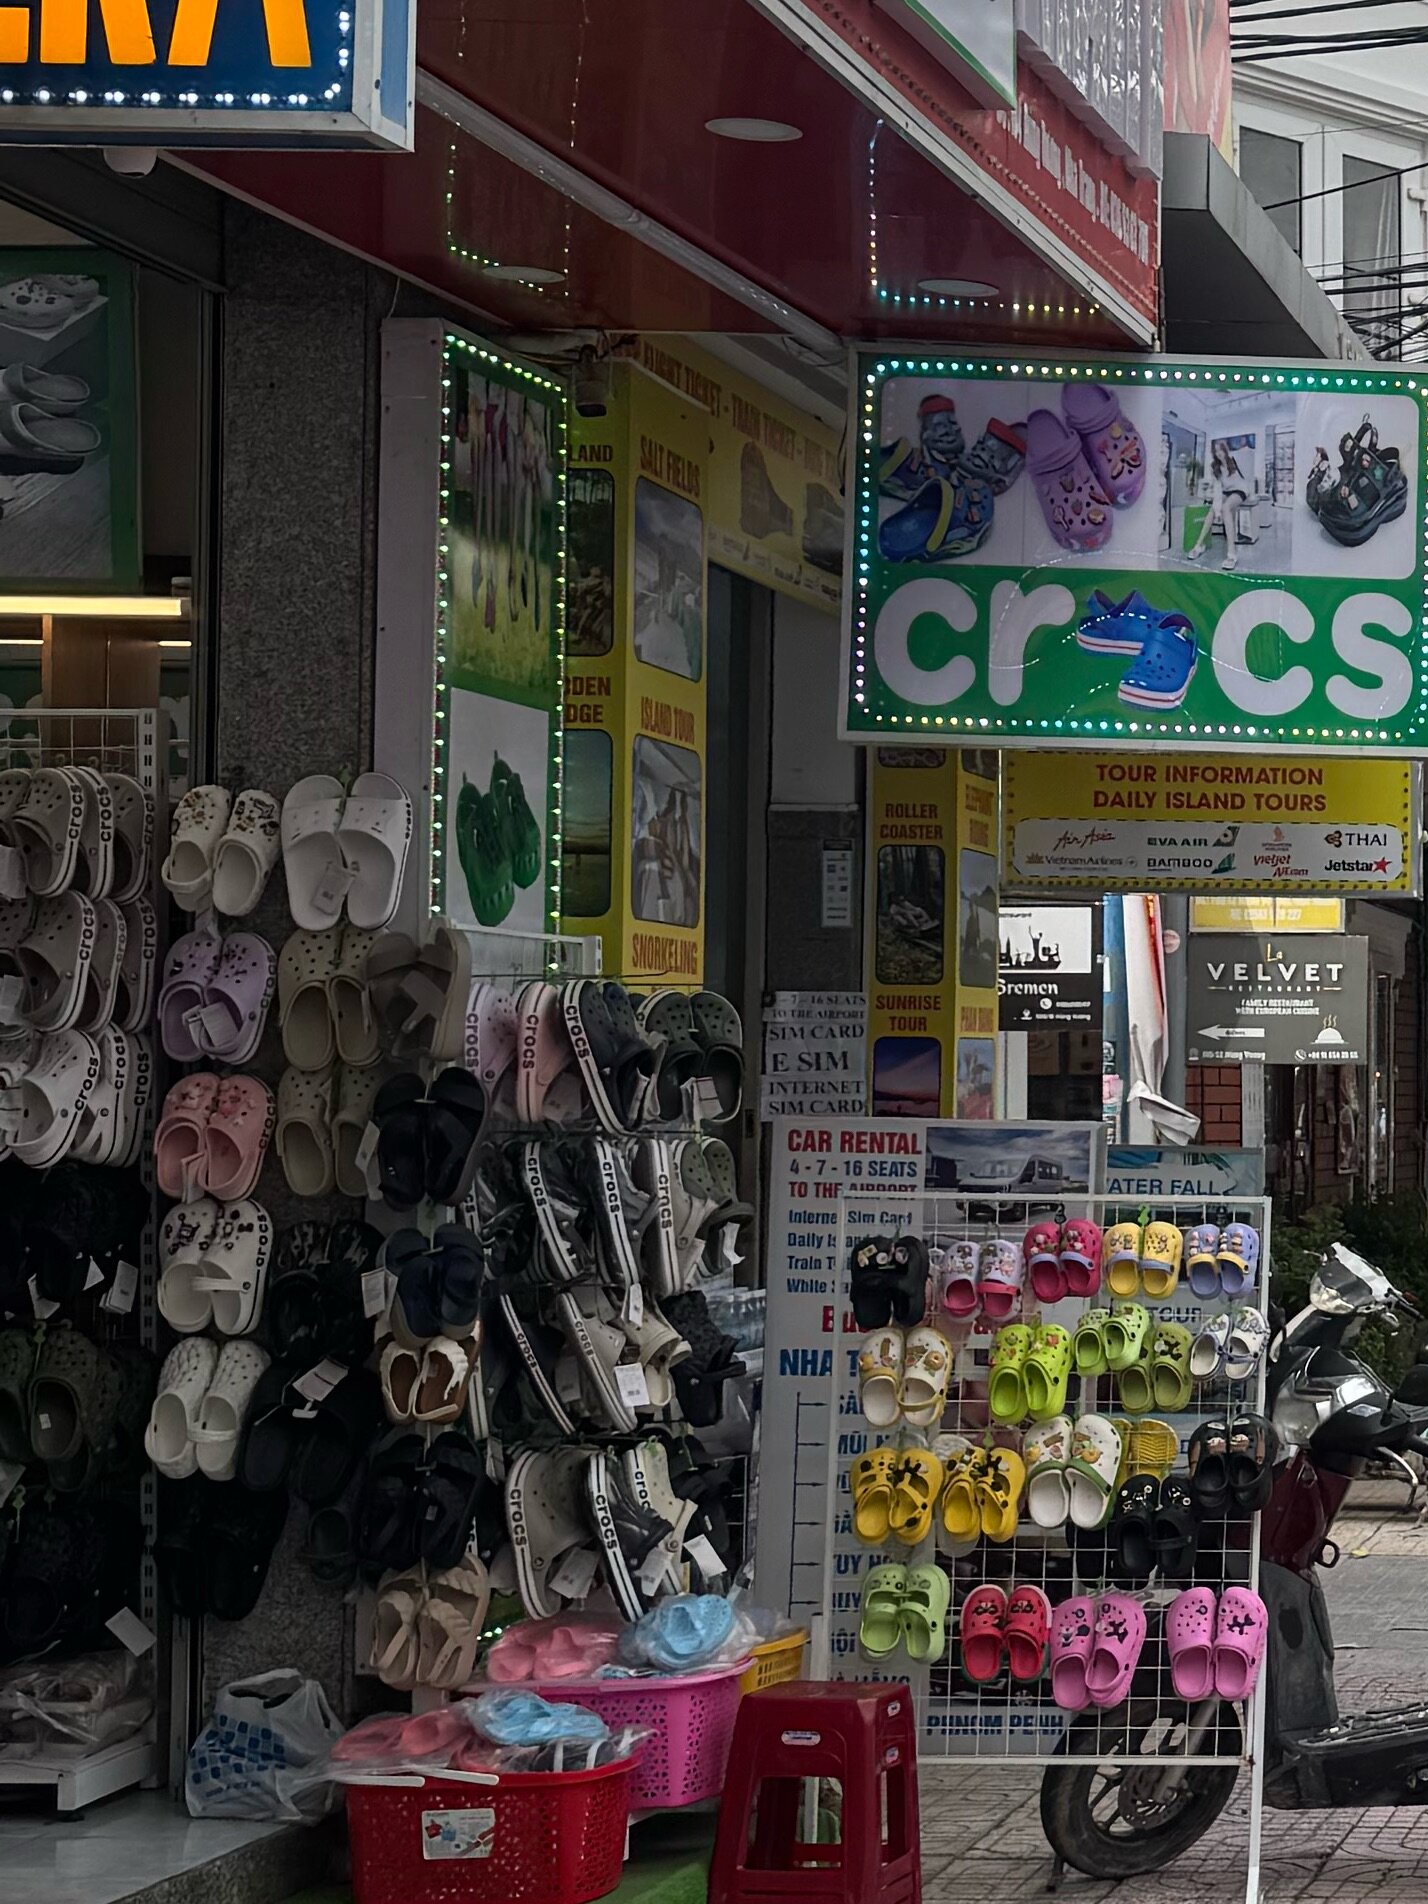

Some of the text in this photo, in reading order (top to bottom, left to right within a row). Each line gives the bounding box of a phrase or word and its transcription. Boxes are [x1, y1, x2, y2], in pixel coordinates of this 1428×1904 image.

[568, 445, 613, 462] LAND
[640, 435, 701, 499] SALT FIELDS
[874, 577, 1414, 720] crcs
[641, 696, 696, 745] ISLAND TOUR
[1096, 764, 1324, 786] TOUR INFORMATION
[69, 784, 83, 840] crocs
[885, 803, 938, 819] ROLLER
[1093, 791, 1327, 812] DAILY ISLAND TOURS
[100, 787, 113, 842] crocs
[880, 824, 943, 840] COASTER
[1180, 837, 1209, 847] AIR
[1345, 833, 1387, 847] THAI
[1325, 860, 1374, 872] Jetstar
[80, 907, 93, 961] crocs
[632, 934, 699, 975] SNORKELING
[1267, 943, 1283, 962] La
[1207, 962, 1344, 982] VELVET
[875, 994, 942, 1012] SUNRISE
[565, 1005, 591, 1058] crocs
[770, 1024, 864, 1041] SIM CARD
[889, 1016, 927, 1032] TOUR
[466, 1013, 479, 1068] crocs
[522, 1014, 539, 1069] crocs
[115, 1033, 126, 1089] crocs
[772, 1050, 849, 1072] E SIM
[75, 1056, 100, 1110] crocs
[134, 1052, 149, 1106] crocs
[769, 1080, 863, 1095] INTERNET
[769, 1099, 863, 1115] SIM CARD
[787, 1129, 922, 1155] CAR RENTAL
[790, 1161, 799, 1175] 4
[816, 1160, 826, 1176] 7
[844, 1160, 862, 1176] 16
[868, 1160, 917, 1177] SEATS
[527, 1157, 547, 1207] crocs
[603, 1162, 620, 1213] crocs
[788, 1182, 808, 1198] TO
[1107, 1179, 1218, 1196] ATER FALL
[788, 1210, 913, 1226] Interne Sim Card
[788, 1232, 823, 1248] Daily
[787, 1255, 823, 1270] Train
[787, 1278, 827, 1294] White
[779, 1348, 834, 1376] NHA
[634, 1471, 652, 1512] croc
[510, 1488, 526, 1546] crocs
[596, 1494, 618, 1549] crocs
[927, 1714, 1065, 1736] PHNOM PENH
